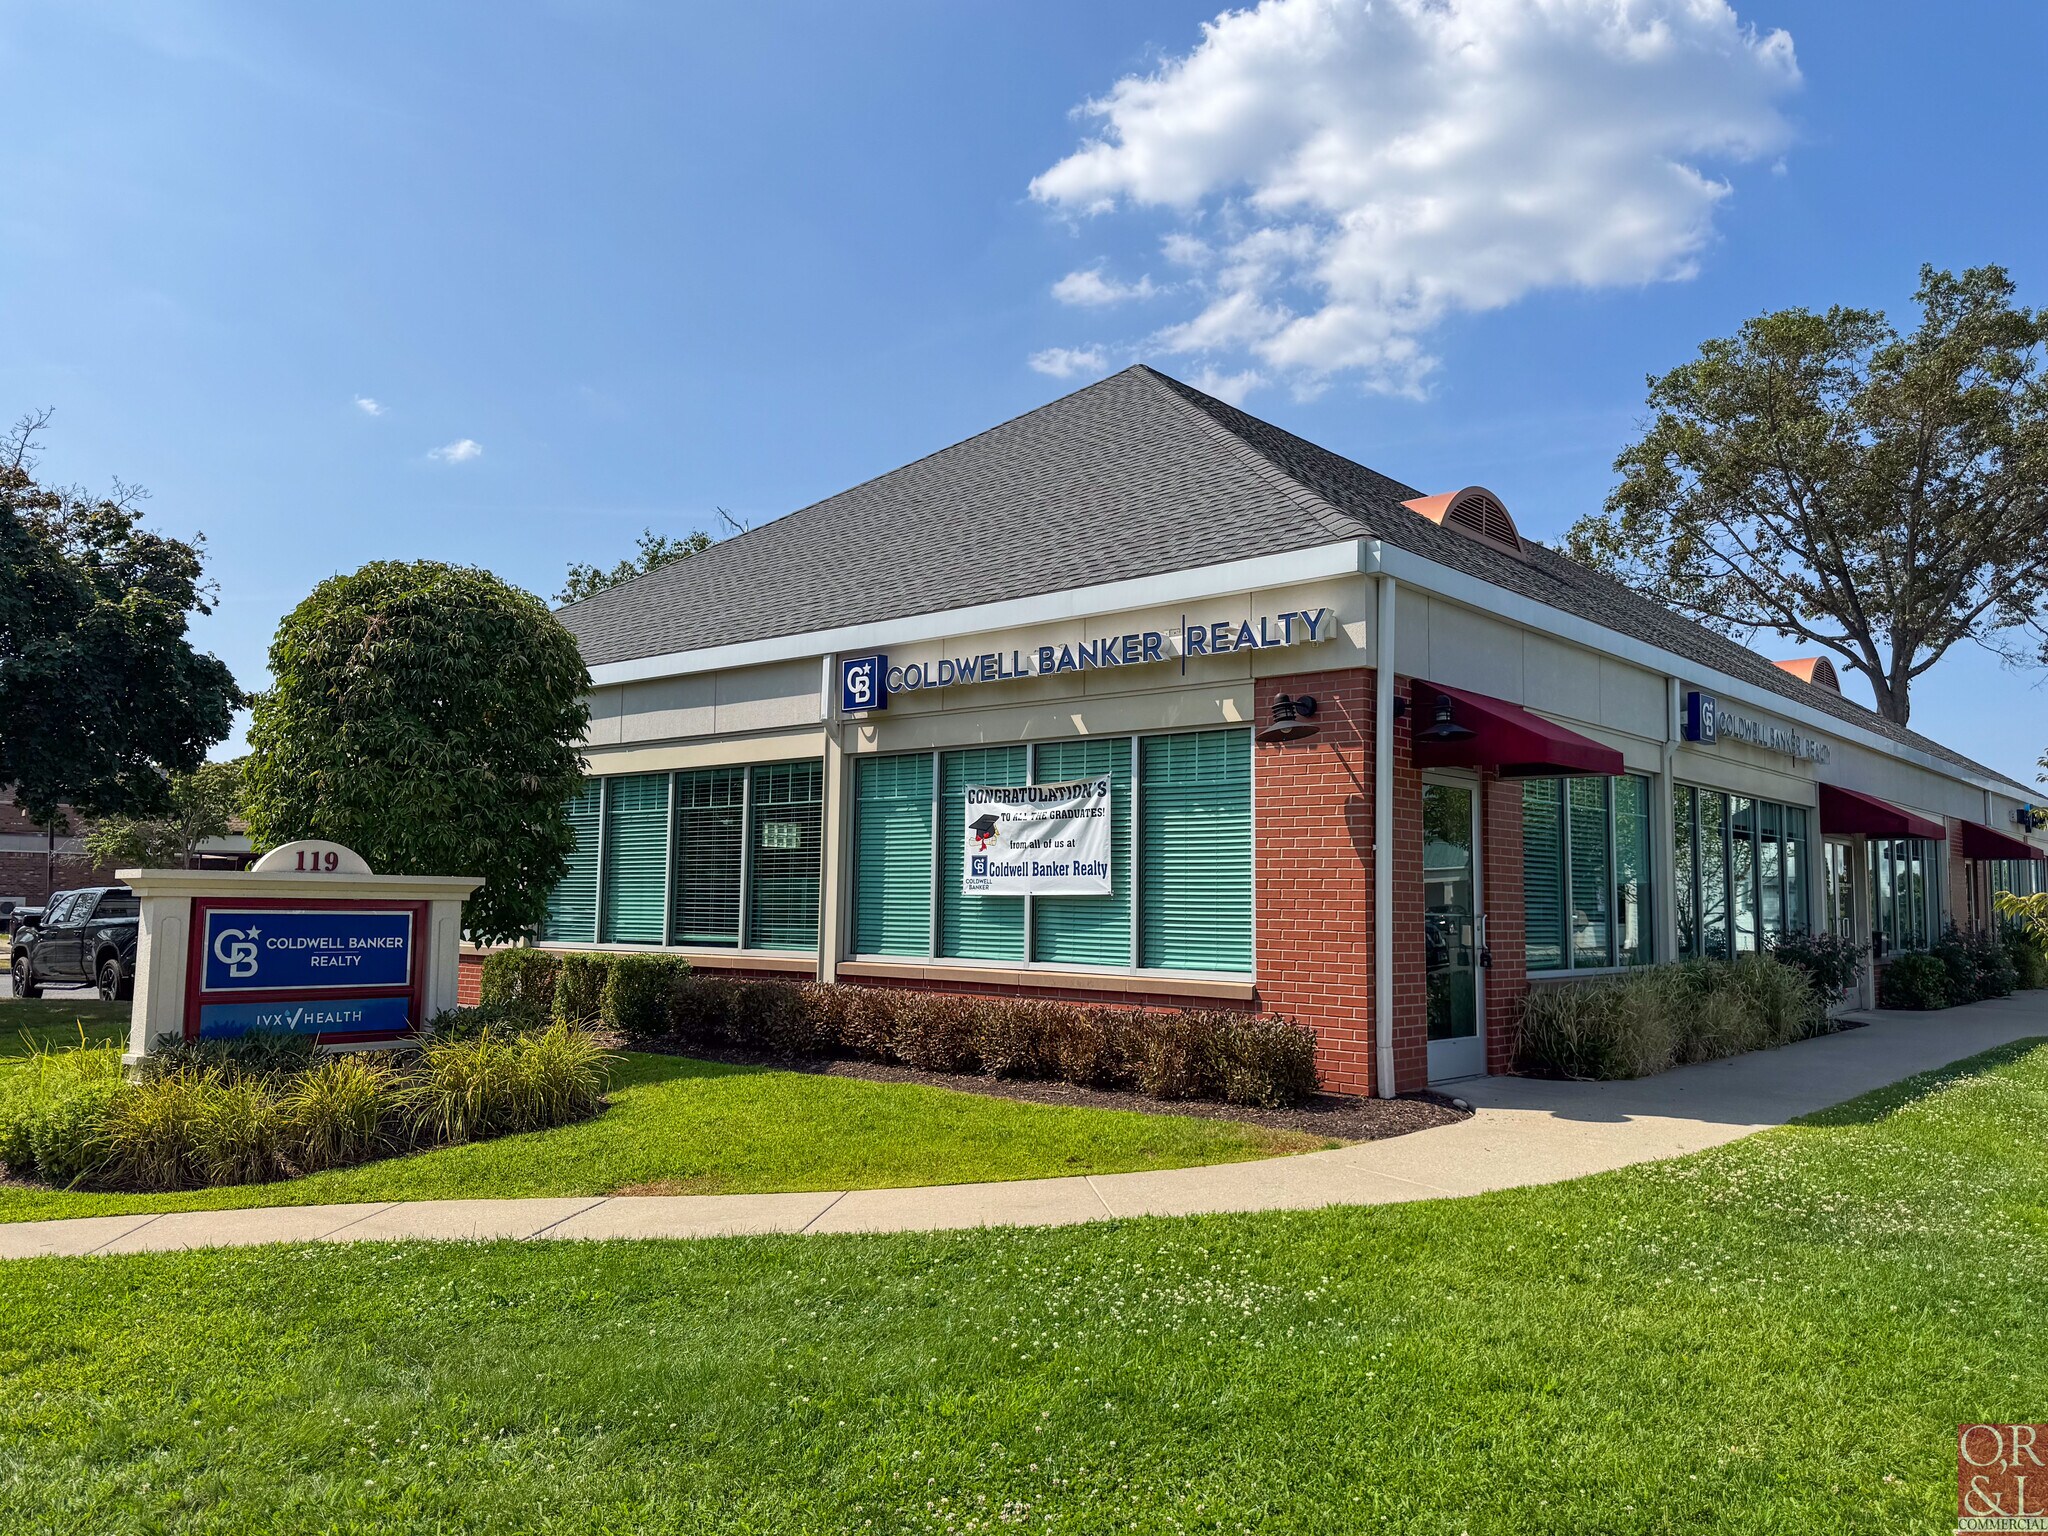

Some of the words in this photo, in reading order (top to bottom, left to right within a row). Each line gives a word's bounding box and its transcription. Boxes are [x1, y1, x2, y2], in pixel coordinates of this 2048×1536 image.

[886, 650, 1029, 695] COLDWELL
[1038, 631, 1163, 675] BANKER
[1186, 607, 1327, 657] REALTY
[1719, 711, 1768, 747] COLDWELL
[967, 780, 1107, 804] CONGRATULATION'S
[1000, 812, 1011, 822] TO
[1049, 807, 1106, 820] GRADUATES!
[1010, 840, 1027, 850] from
[1029, 839, 1041, 849] all
[1043, 839, 1052, 849] of
[1054, 840, 1065, 849] us
[1066, 839, 1076, 848] at
[294, 850, 339, 872] 119
[989, 861, 1029, 878] Coldwell
[1032, 861, 1070, 877] Banker
[1072, 860, 1108, 879] Realty
[266, 937, 345, 950] COLDWELL
[348, 937, 403, 949] BANKER
[310, 955, 361, 967] REALTY
[256, 1014, 282, 1026] IVX
[304, 1011, 362, 1024] HEALTH
